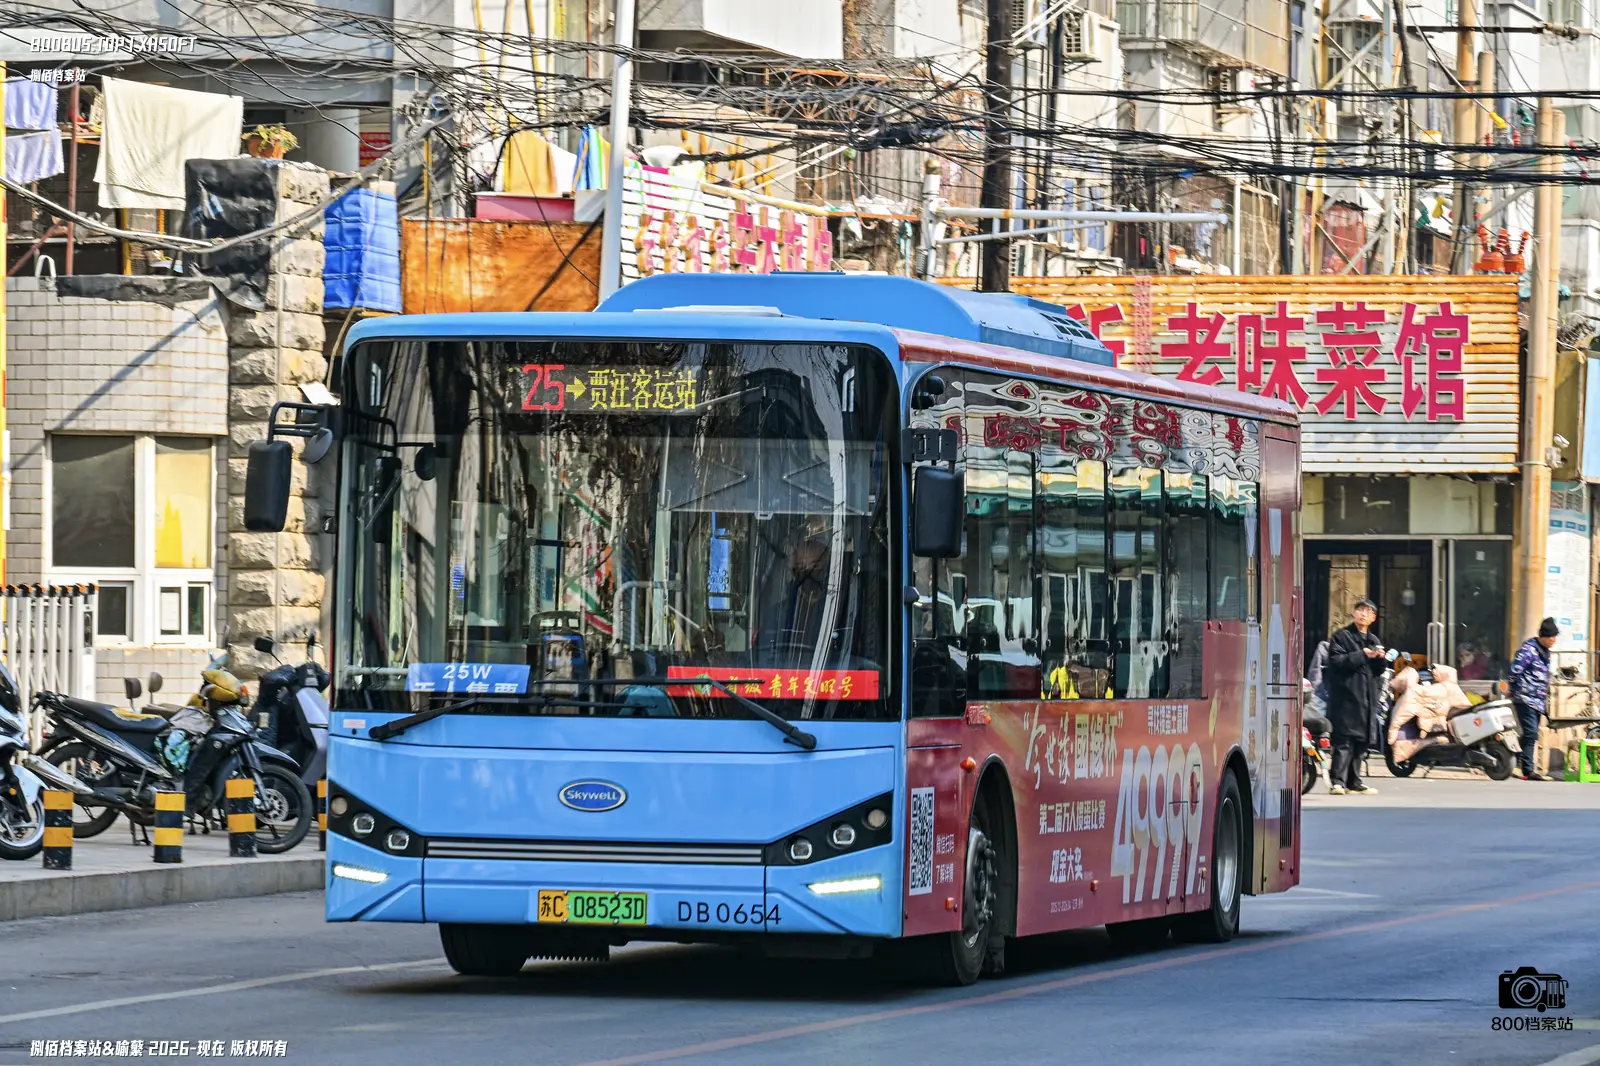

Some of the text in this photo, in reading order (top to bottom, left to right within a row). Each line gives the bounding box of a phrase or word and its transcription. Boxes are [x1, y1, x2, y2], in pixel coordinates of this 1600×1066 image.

[521, 364, 697, 411] 25 贾汪客运站
[443, 665, 492, 680] 25W
[1039, 800, 1106, 835] 第二届万人掼蛋比赛
[1050, 847, 1083, 883] 现金大奖
